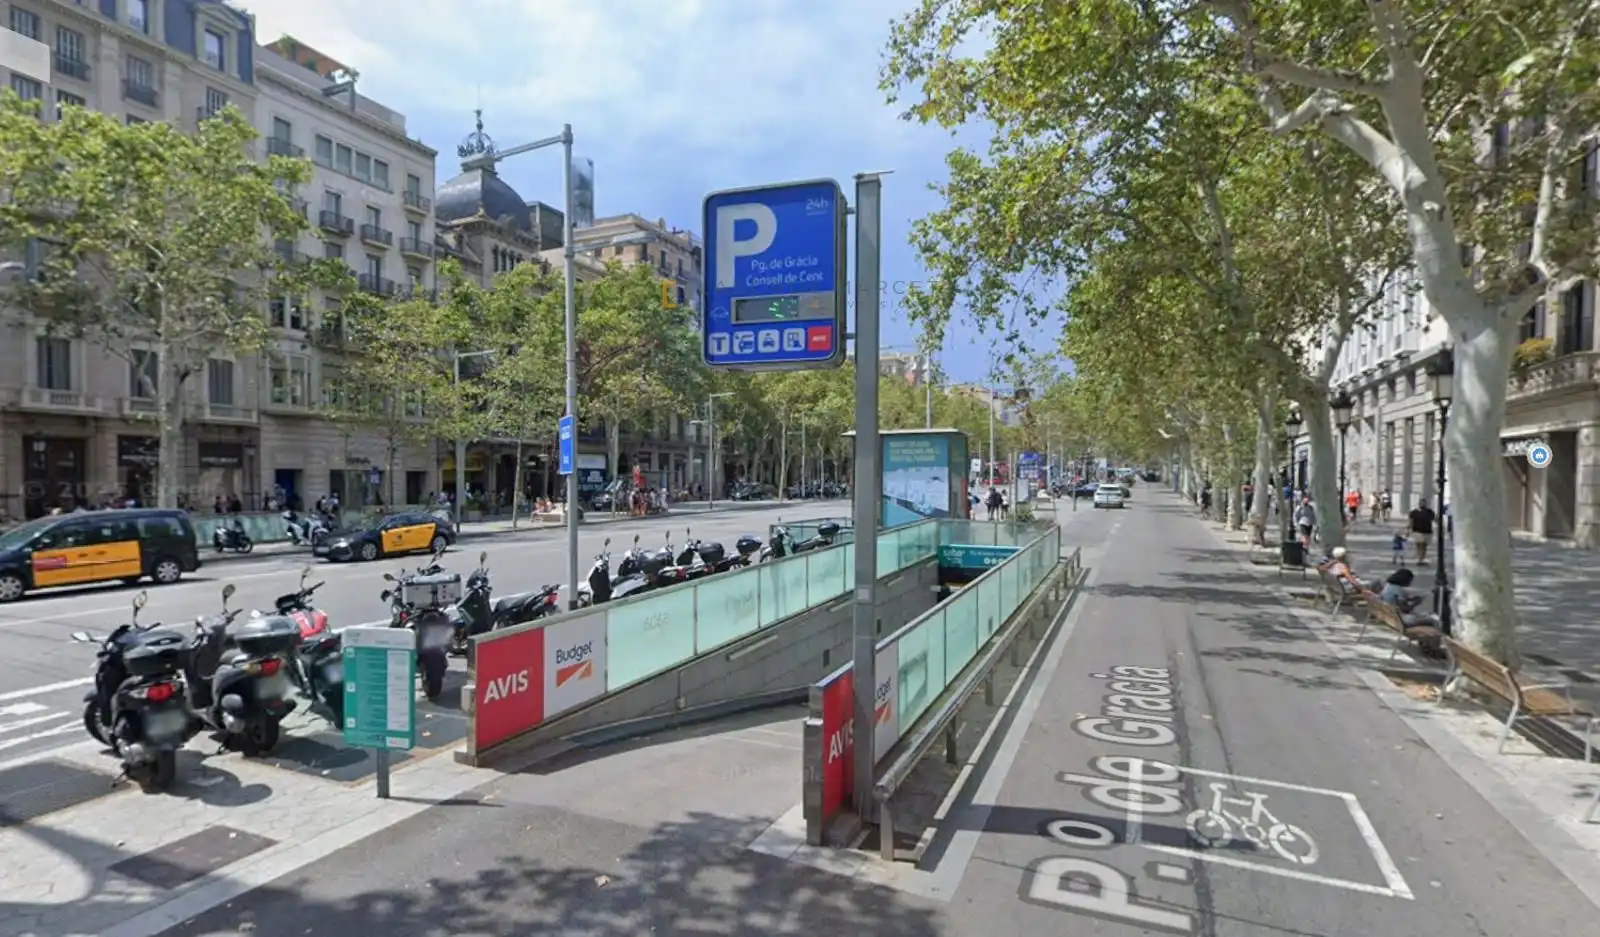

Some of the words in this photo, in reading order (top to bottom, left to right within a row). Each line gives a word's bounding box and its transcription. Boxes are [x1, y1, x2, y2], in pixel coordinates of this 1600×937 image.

[806, 198, 828, 211] 24h
[715, 202, 778, 288] P
[746, 273, 783, 287] Consell
[785, 272, 798, 284] de
[800, 270, 824, 283] Cent
[751, 259, 768, 273] Pg.
[770, 257, 783, 269] de
[556, 640, 593, 664] Budget
[483, 669, 529, 704] AVIS
[1078, 664, 1177, 746] Gracia
[1063, 756, 1184, 814] de
